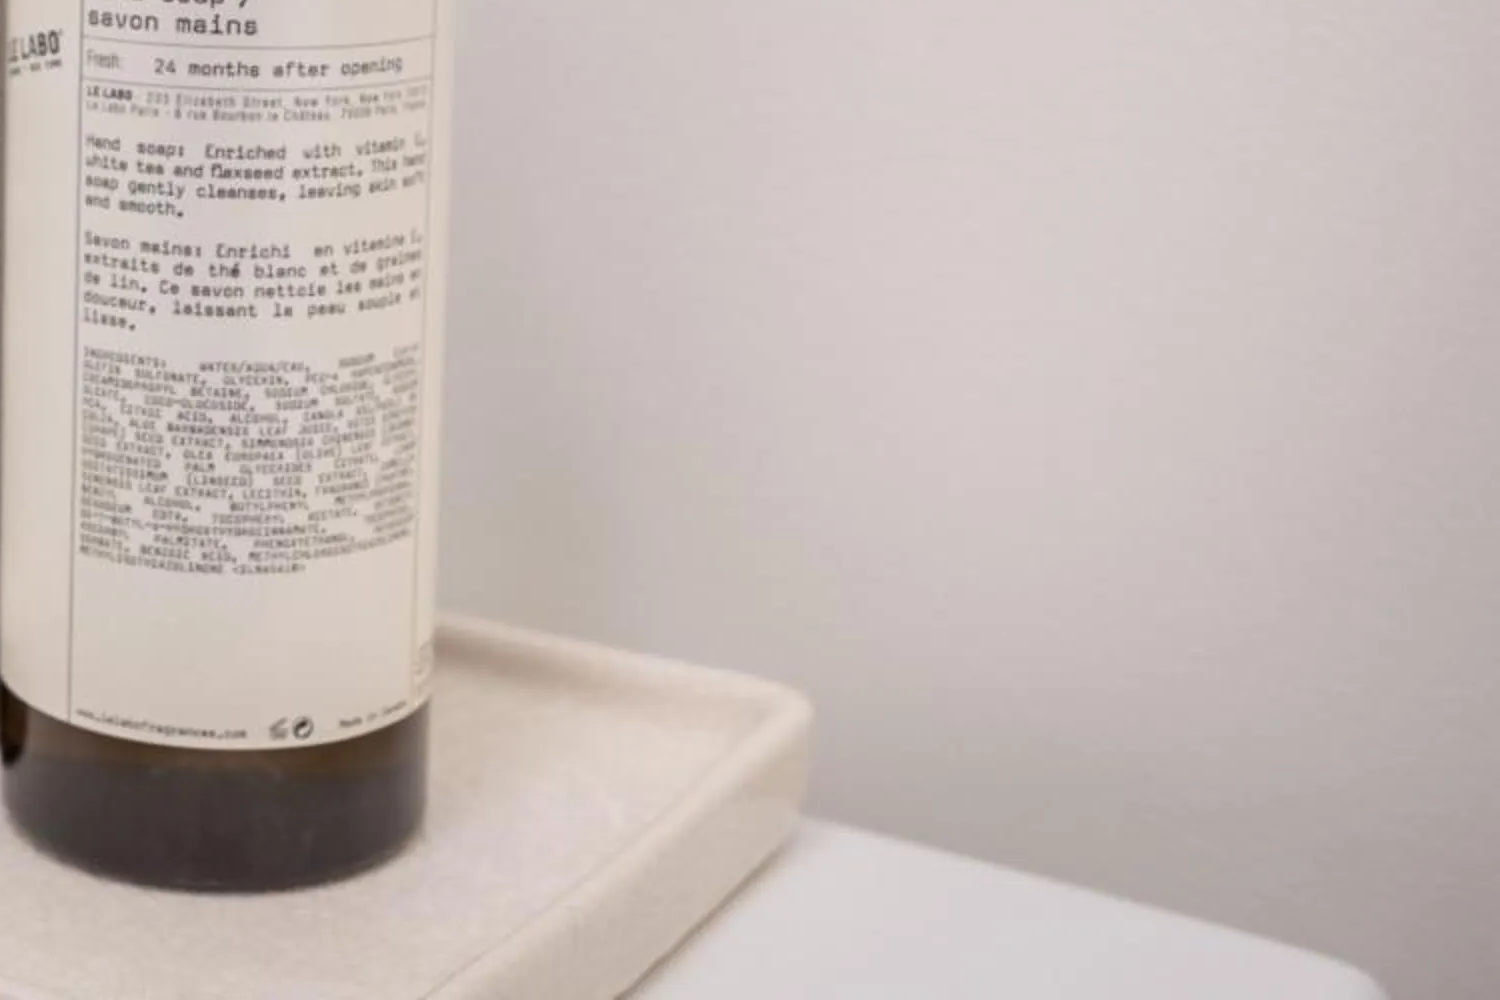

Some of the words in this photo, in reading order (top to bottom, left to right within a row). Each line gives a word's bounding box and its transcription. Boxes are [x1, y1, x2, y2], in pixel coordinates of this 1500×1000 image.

[88, 8, 159, 32] savon
[175, 11, 258, 36] mains
[154, 57, 176, 75] 24
[188, 58, 260, 78] months
[272, 57, 330, 77] after
[341, 55, 403, 78] opening
[84, 135, 121, 152] Hand
[205, 143, 287, 161] Enriched
[302, 143, 342, 160] with
[85, 154, 129, 172] white
[136, 159, 165, 176] tea
[173, 163, 204, 179] and
[292, 162, 364, 180] extract.
[85, 174, 119, 192] soap
[127, 178, 186, 200] gently
[196, 183, 287, 202] cleanses,
[299, 183, 362, 199] leaving
[85, 194, 111, 210] and
[118, 199, 184, 218] smooth.
[84, 230, 130, 250] Savon
[216, 242, 291, 259] Enrichi
[314, 245, 334, 259] en
[84, 252, 160, 276] extraits
[173, 260, 195, 278] de
[208, 261, 241, 279] thé
[253, 262, 308, 280] blanc
[319, 261, 340, 277] et
[84, 270, 101, 286] de
[110, 273, 149, 294] lin.
[159, 278, 181, 296] Ce
[191, 284, 245, 299] savon
[253, 281, 328, 299] nettoie
[336, 279, 362, 296] les
[84, 306, 137, 332] lisse.
[172, 299, 259, 319] laissant
[273, 302, 293, 319] la
[307, 302, 347, 320] peau
